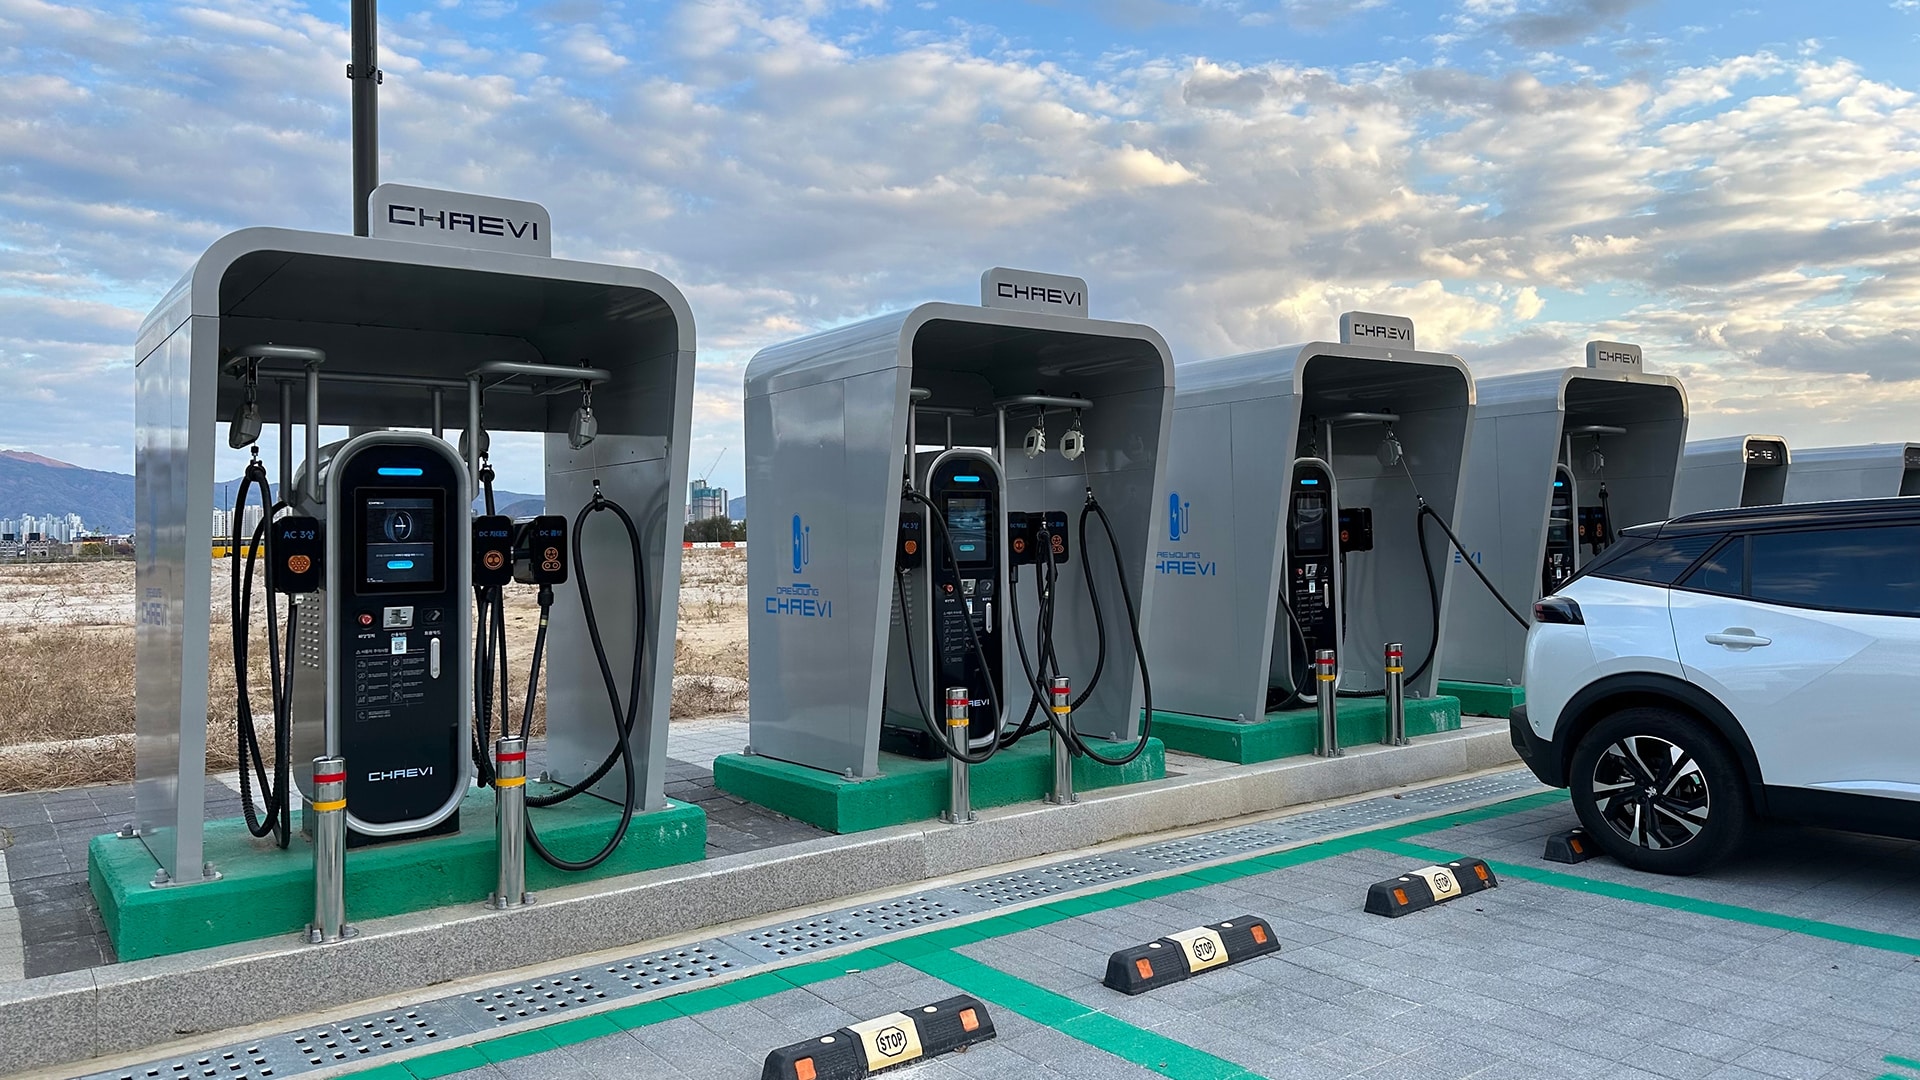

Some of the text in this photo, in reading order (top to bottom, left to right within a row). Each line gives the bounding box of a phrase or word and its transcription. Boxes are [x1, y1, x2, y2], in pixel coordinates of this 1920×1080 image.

[388, 204, 538, 241] CHAEVI
[997, 282, 1081, 306] CHAEVI
[1354, 323, 1410, 341] CHAEVI
[1599, 350, 1640, 365] CHAEVI
[283, 530, 315, 540] AC 3상
[1156, 551, 1201, 559] AEYOUNG
[1155, 560, 1216, 576] HAEVI
[776, 586, 820, 597] DAEYOUNG
[765, 597, 832, 618] CHAEVI
[368, 766, 433, 782] CHAEVI
[1436, 877, 1449, 889] STOP
[1196, 942, 1213, 957] STOP
[879, 1032, 903, 1051] STOP
